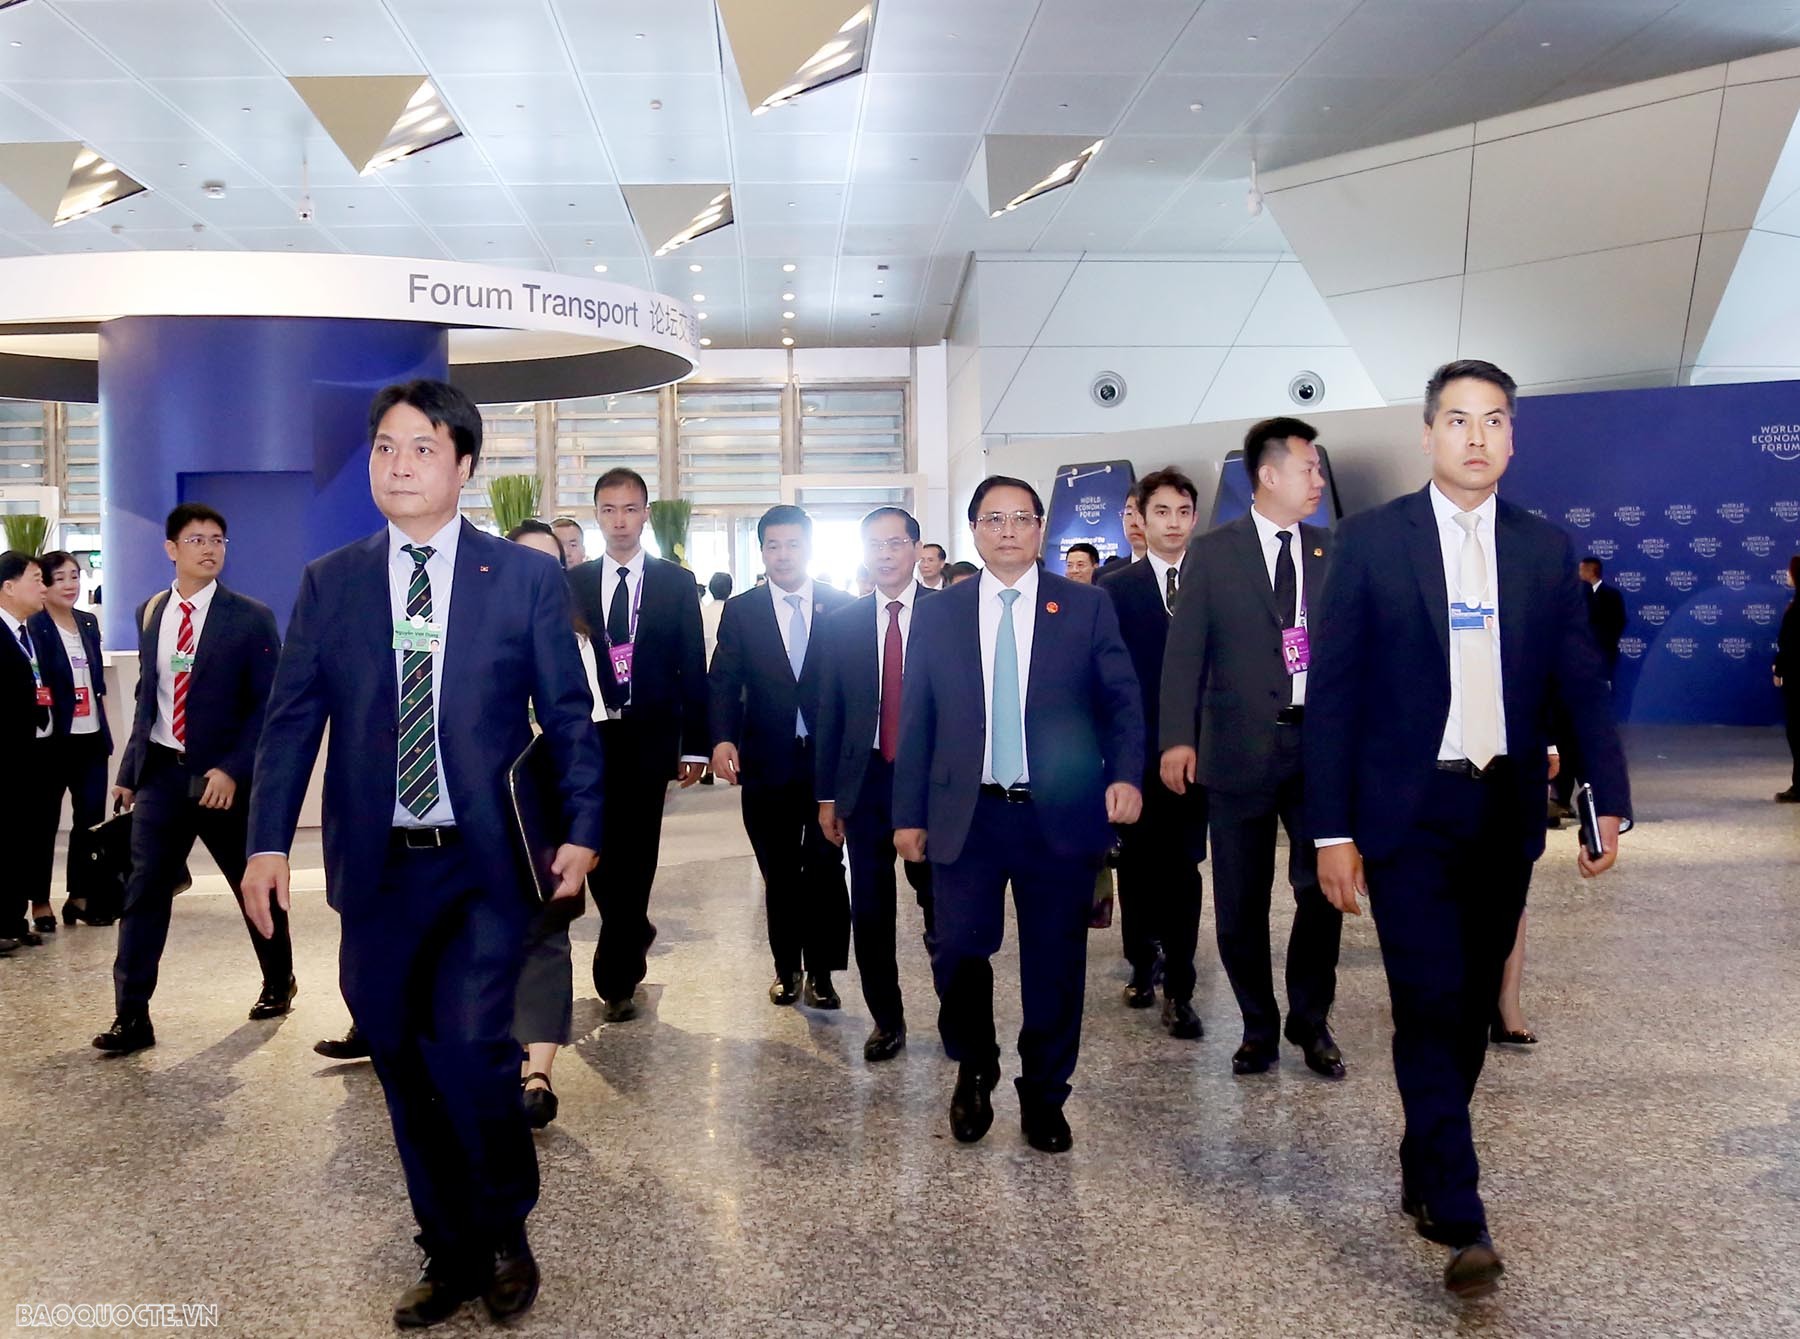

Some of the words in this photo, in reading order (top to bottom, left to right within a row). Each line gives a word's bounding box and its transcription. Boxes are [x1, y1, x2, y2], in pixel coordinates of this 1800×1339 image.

[409, 273, 513, 310] Forum
[522, 283, 639, 328] Transport
[1760, 424, 1800, 434] WORLD
[1752, 434, 1800, 444] ECONOM
[1761, 443, 1800, 452] FORUM
[1075, 503, 1106, 511] ECONOMIC
